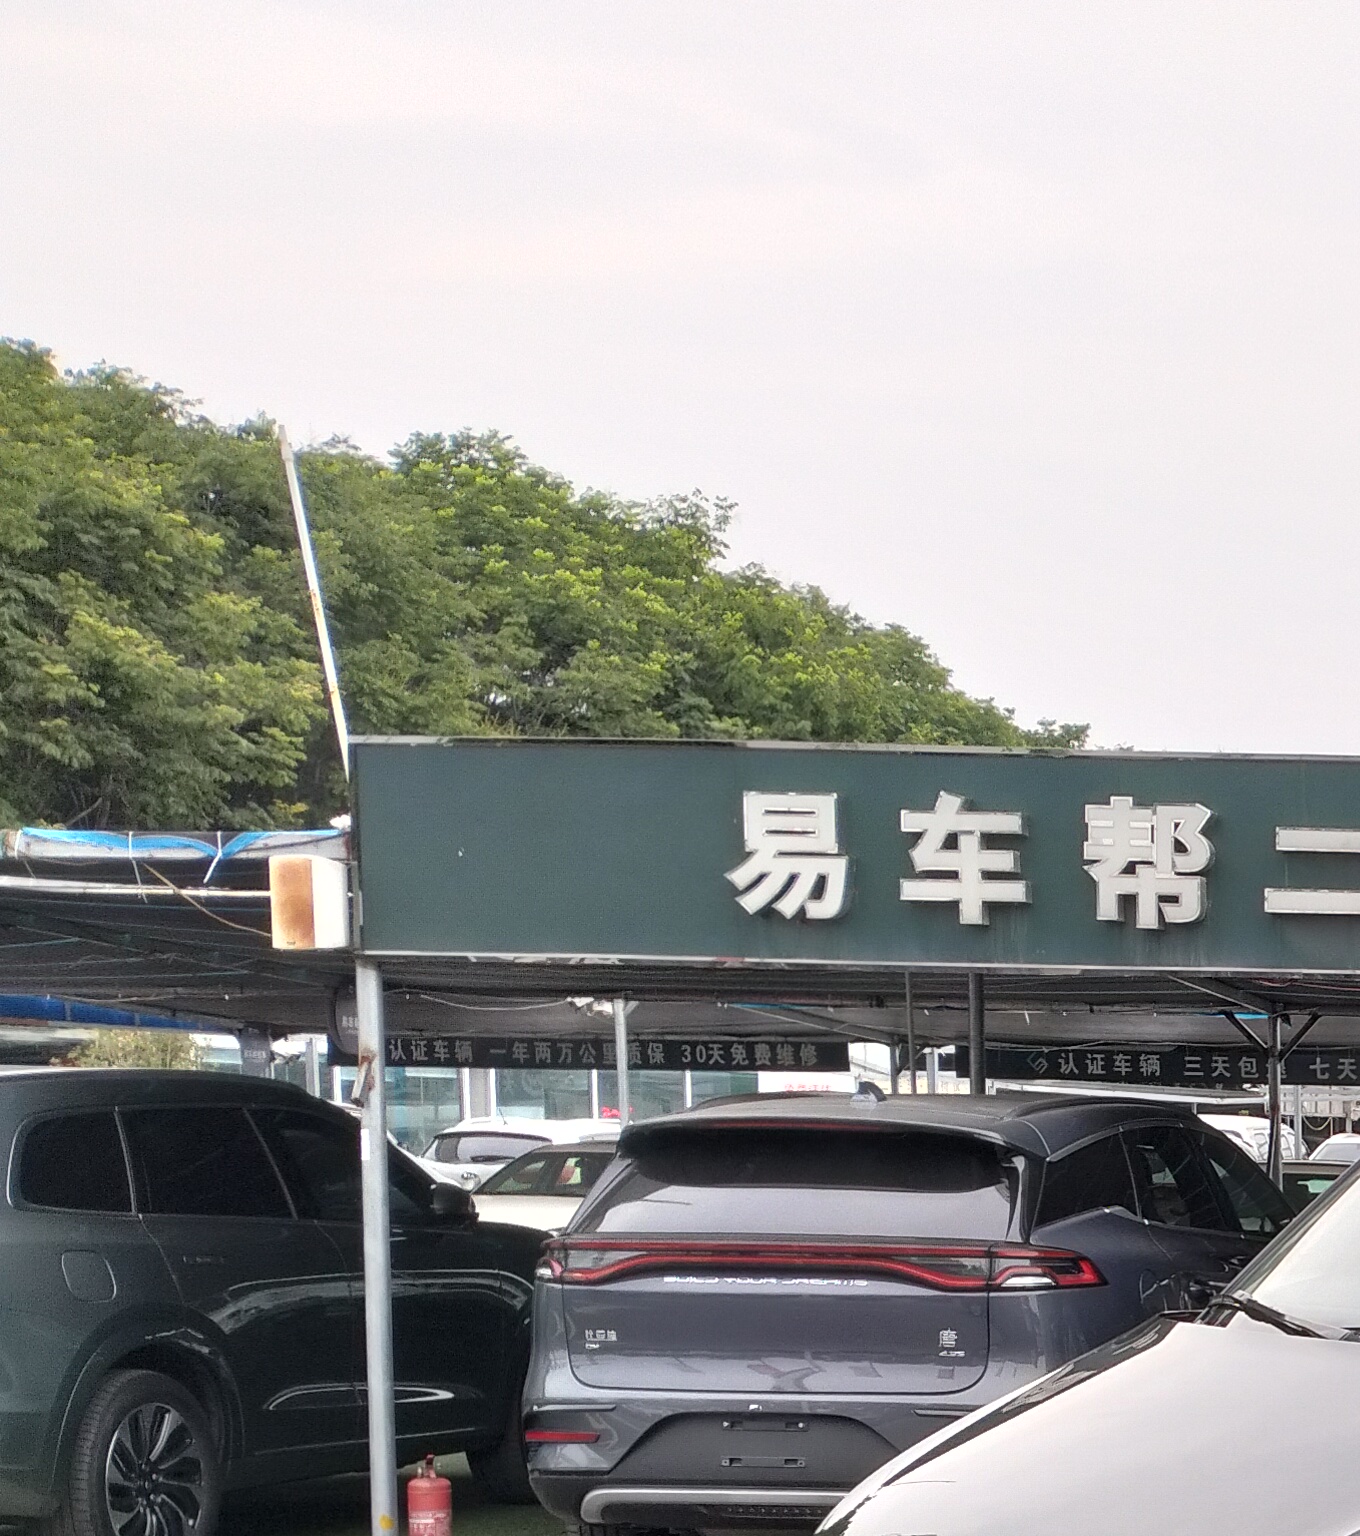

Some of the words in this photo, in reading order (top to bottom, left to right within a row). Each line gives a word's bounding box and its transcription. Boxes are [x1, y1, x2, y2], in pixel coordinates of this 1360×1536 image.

[388, 1038, 474, 1064] 认证车辆
[680, 1041, 820, 1068] 30天免费维修
[1058, 1051, 1162, 1078] 认证车辆
